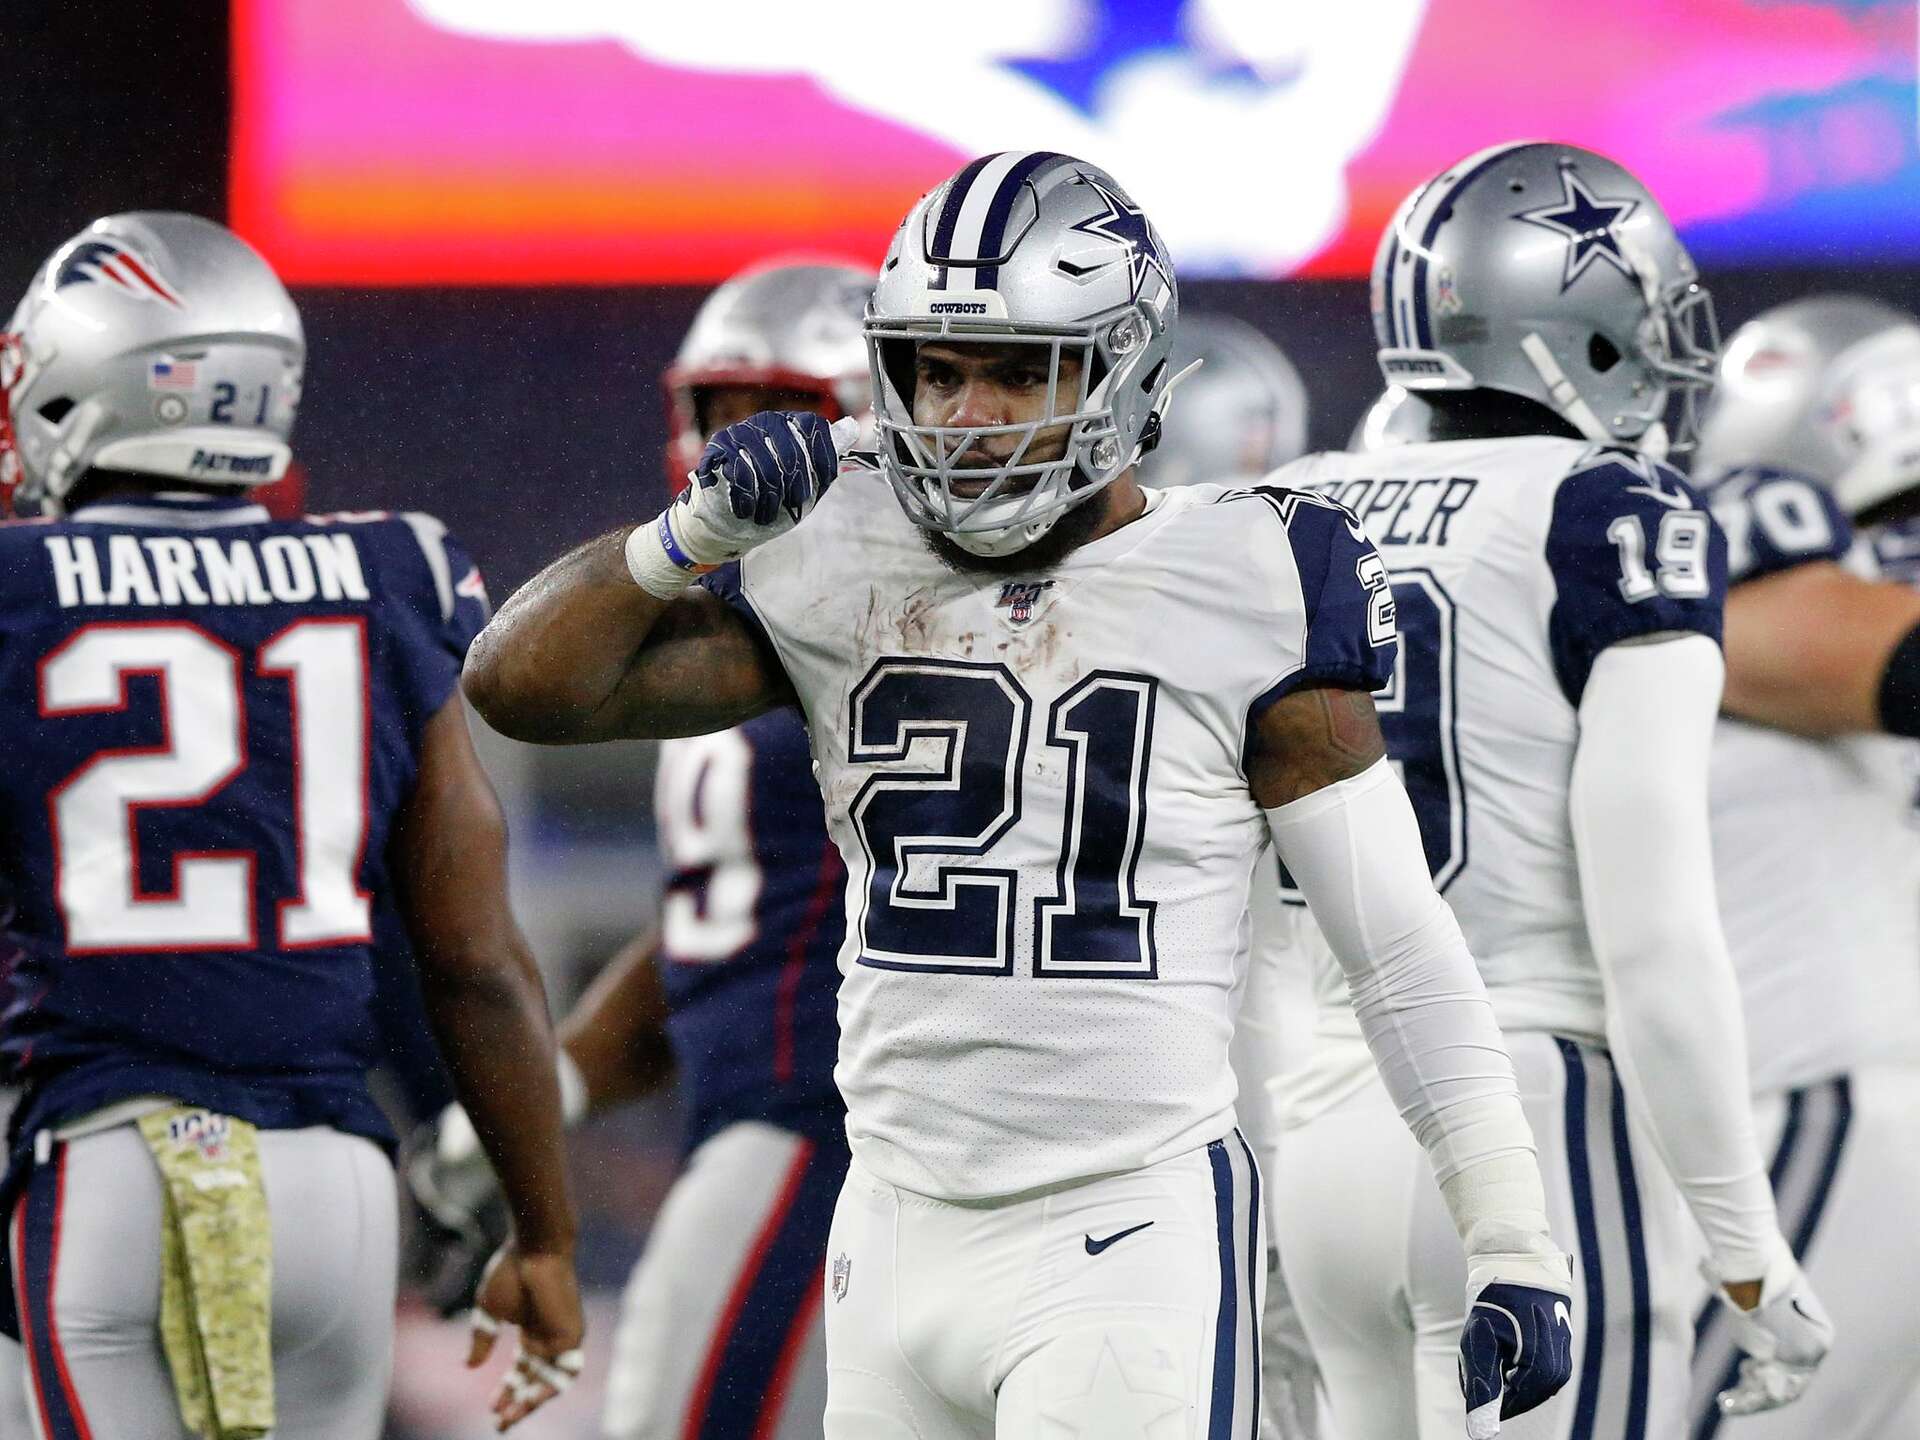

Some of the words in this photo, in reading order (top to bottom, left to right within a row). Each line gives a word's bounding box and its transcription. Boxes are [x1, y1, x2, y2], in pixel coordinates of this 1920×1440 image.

[930, 303, 987, 314] COWBOYS
[210, 380, 271, 425] 21
[45, 531, 370, 608] HARMON
[1606, 508, 1710, 604] 19
[37, 615, 372, 955] 21
[848, 656, 1158, 979] 21
[655, 727, 764, 963] 9
